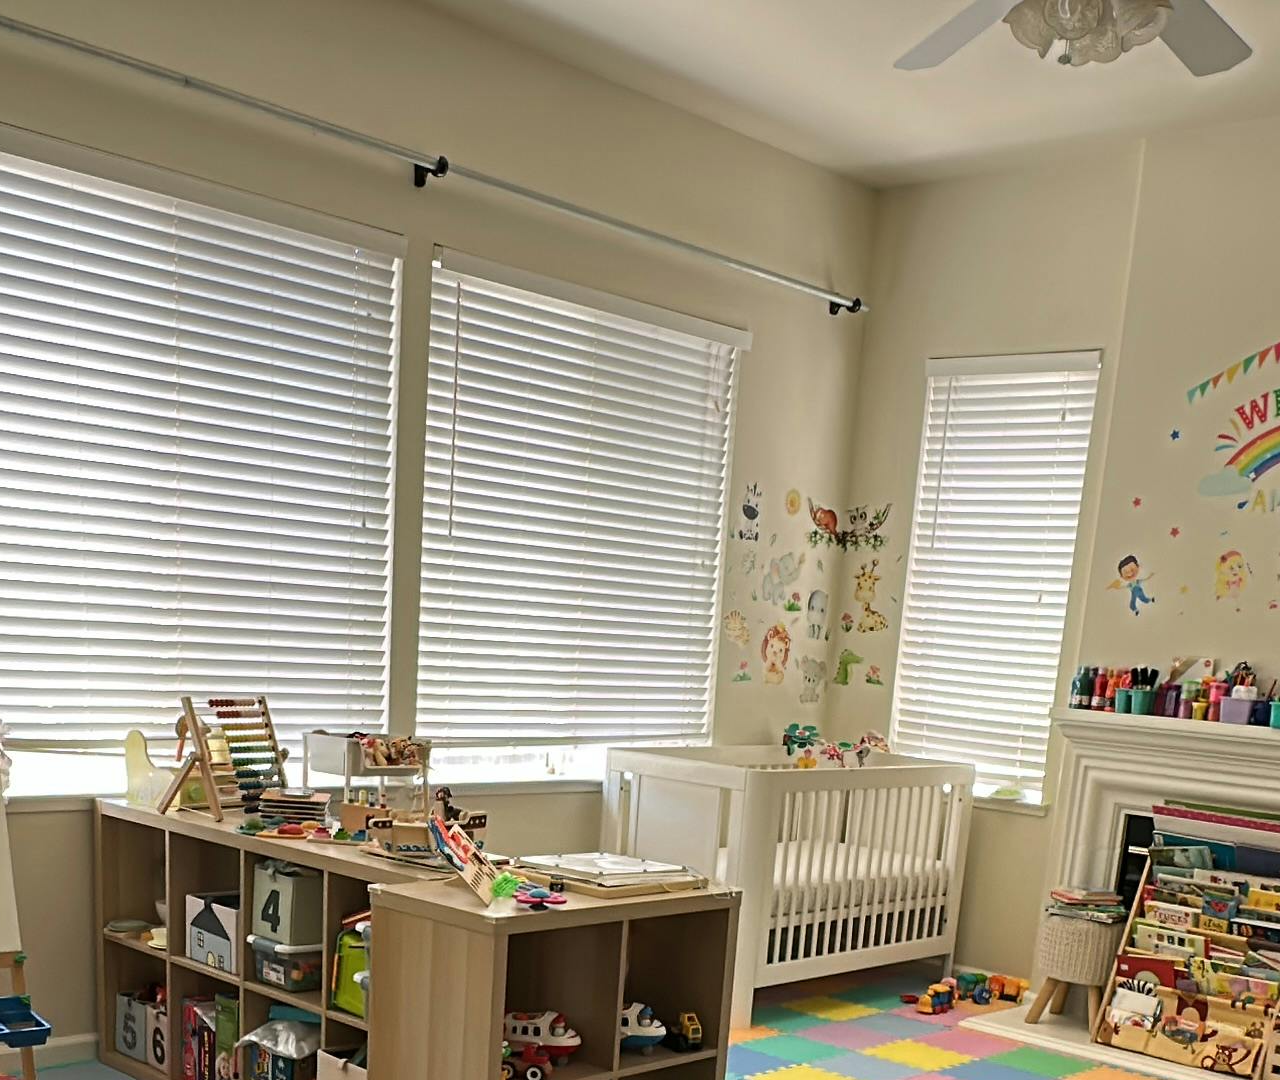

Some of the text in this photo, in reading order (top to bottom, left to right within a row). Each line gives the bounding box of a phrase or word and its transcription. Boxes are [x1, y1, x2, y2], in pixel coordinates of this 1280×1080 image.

[261, 889, 281, 933] 4
[122, 1012, 137, 1050] 5
[152, 1026, 165, 1065] 6
